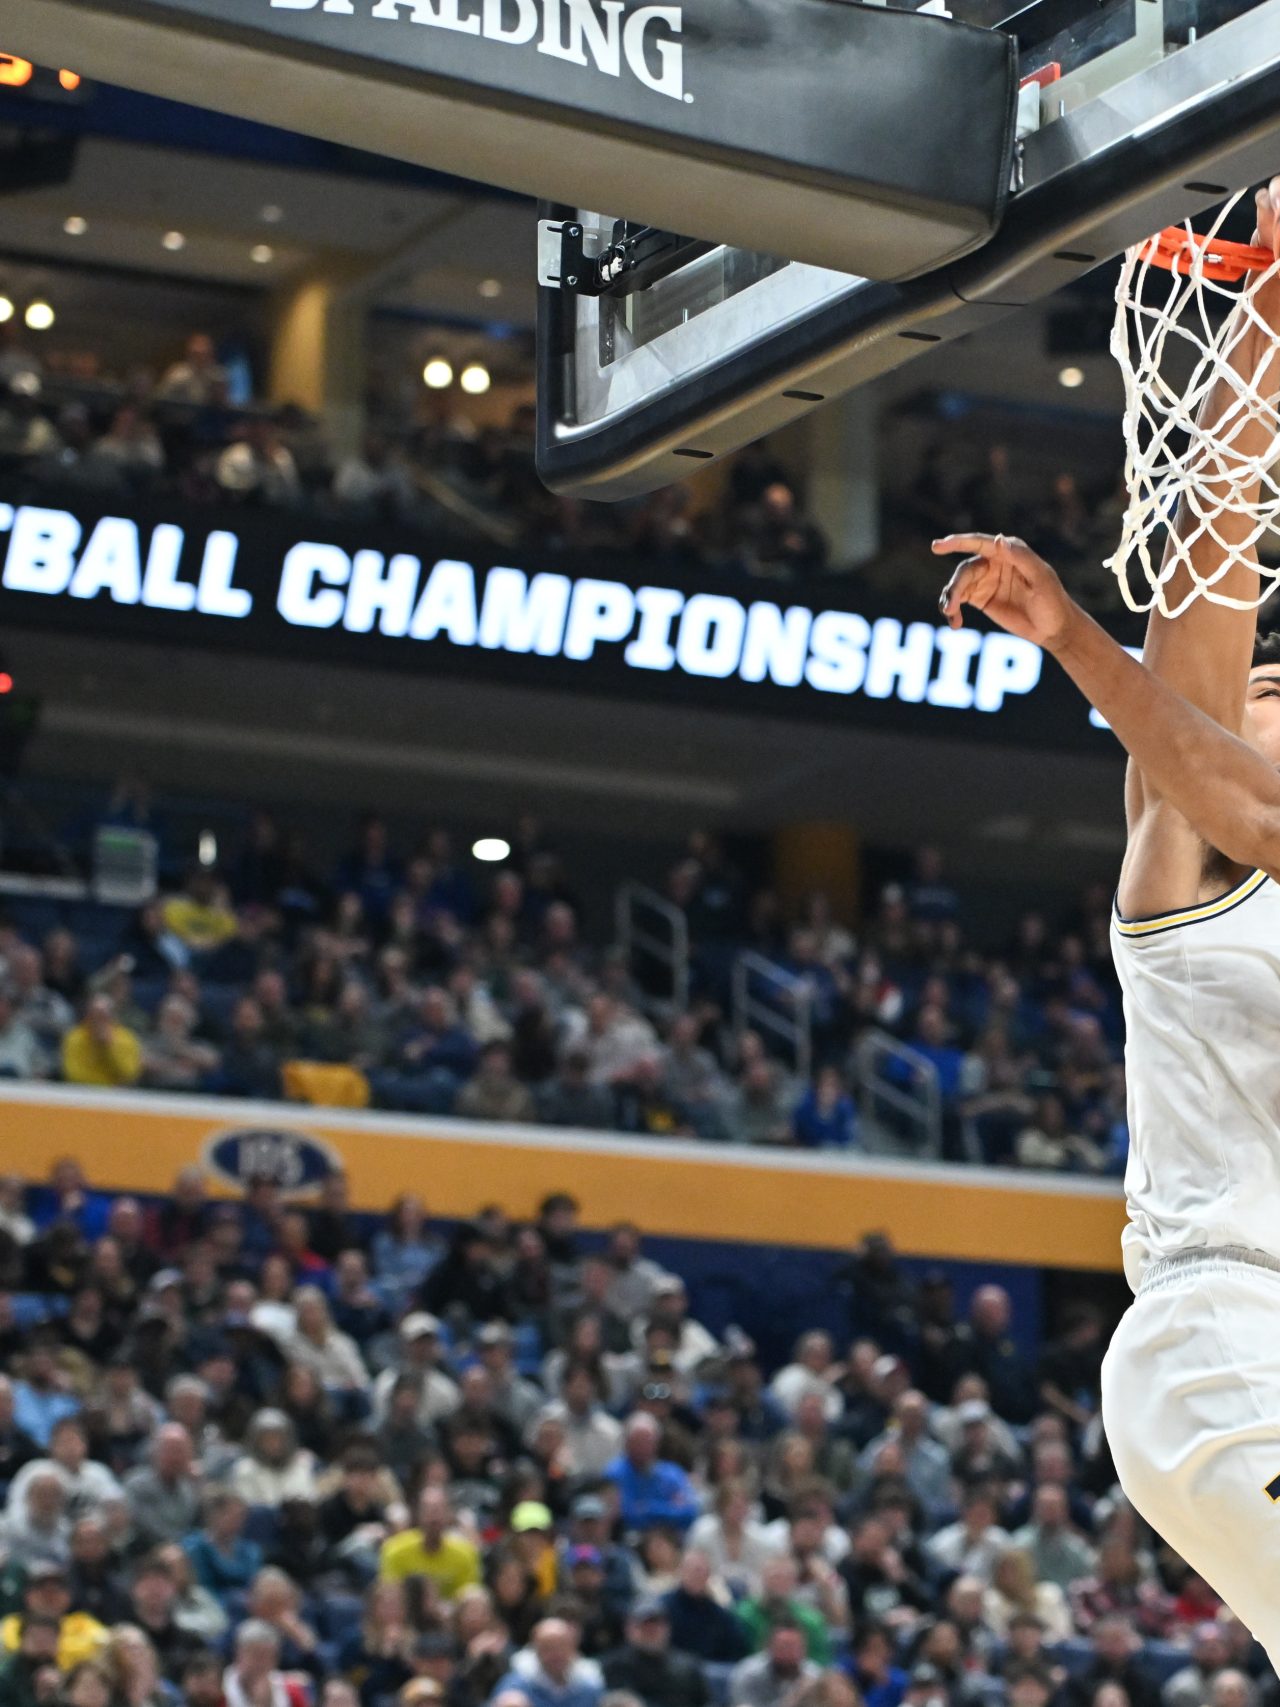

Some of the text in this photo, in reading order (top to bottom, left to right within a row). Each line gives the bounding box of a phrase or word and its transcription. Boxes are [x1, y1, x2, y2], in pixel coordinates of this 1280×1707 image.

[270, 0, 683, 100] ALDING
[0, 504, 253, 618] BALL
[277, 540, 1043, 713] CHAMPIONSHIP
